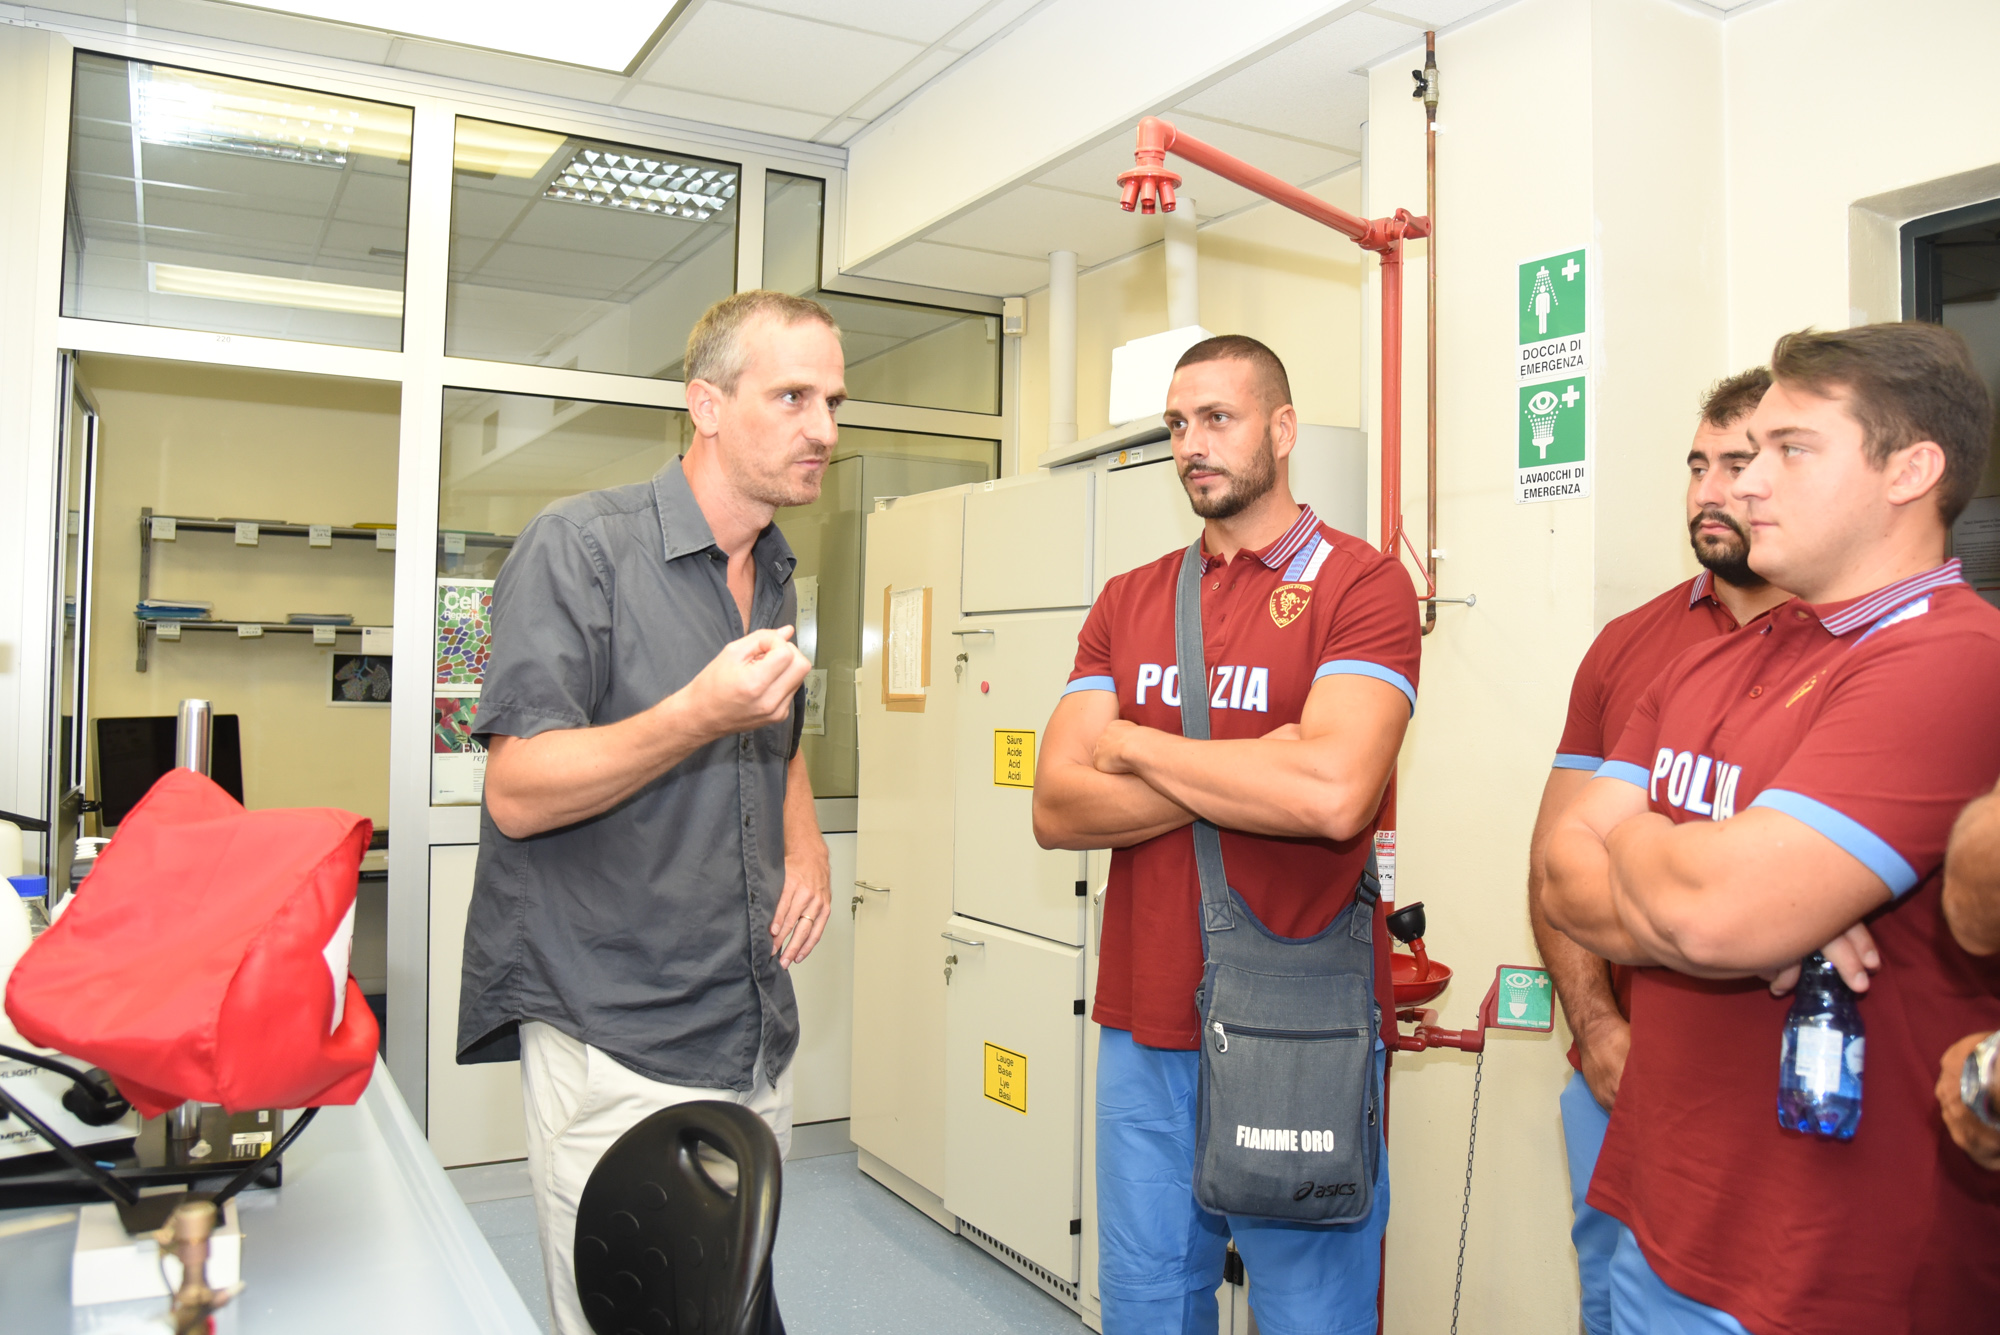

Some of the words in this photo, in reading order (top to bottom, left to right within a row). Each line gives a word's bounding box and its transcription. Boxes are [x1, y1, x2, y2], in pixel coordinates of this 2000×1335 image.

[1523, 343, 1566, 360] DOCCIA
[1570, 339, 1581, 352] DI
[1520, 355, 1584, 376] EMERGENZA
[1520, 469, 1571, 485] LAVAOCCHI
[1575, 467, 1584, 479] DI
[1524, 483, 1580, 498] EMERGENZA
[444, 592, 480, 610] Cell
[444, 609, 480, 620] Reports
[1136, 663, 1269, 713] POZIA
[1007, 735, 1022, 745] Säure
[1007, 747, 1022, 757] Acide
[1009, 759, 1021, 768] Acid
[1008, 771, 1021, 781] Acidi
[996, 1052, 1014, 1067] Lauge
[998, 1064, 1012, 1078] Base
[1000, 1077, 1010, 1089] Lye
[999, 1088, 1011, 1101] Basi
[1236, 1125, 1299, 1152] FIAMME
[1301, 1130, 1335, 1152] ORO
[1315, 1182, 1357, 1198] asics
